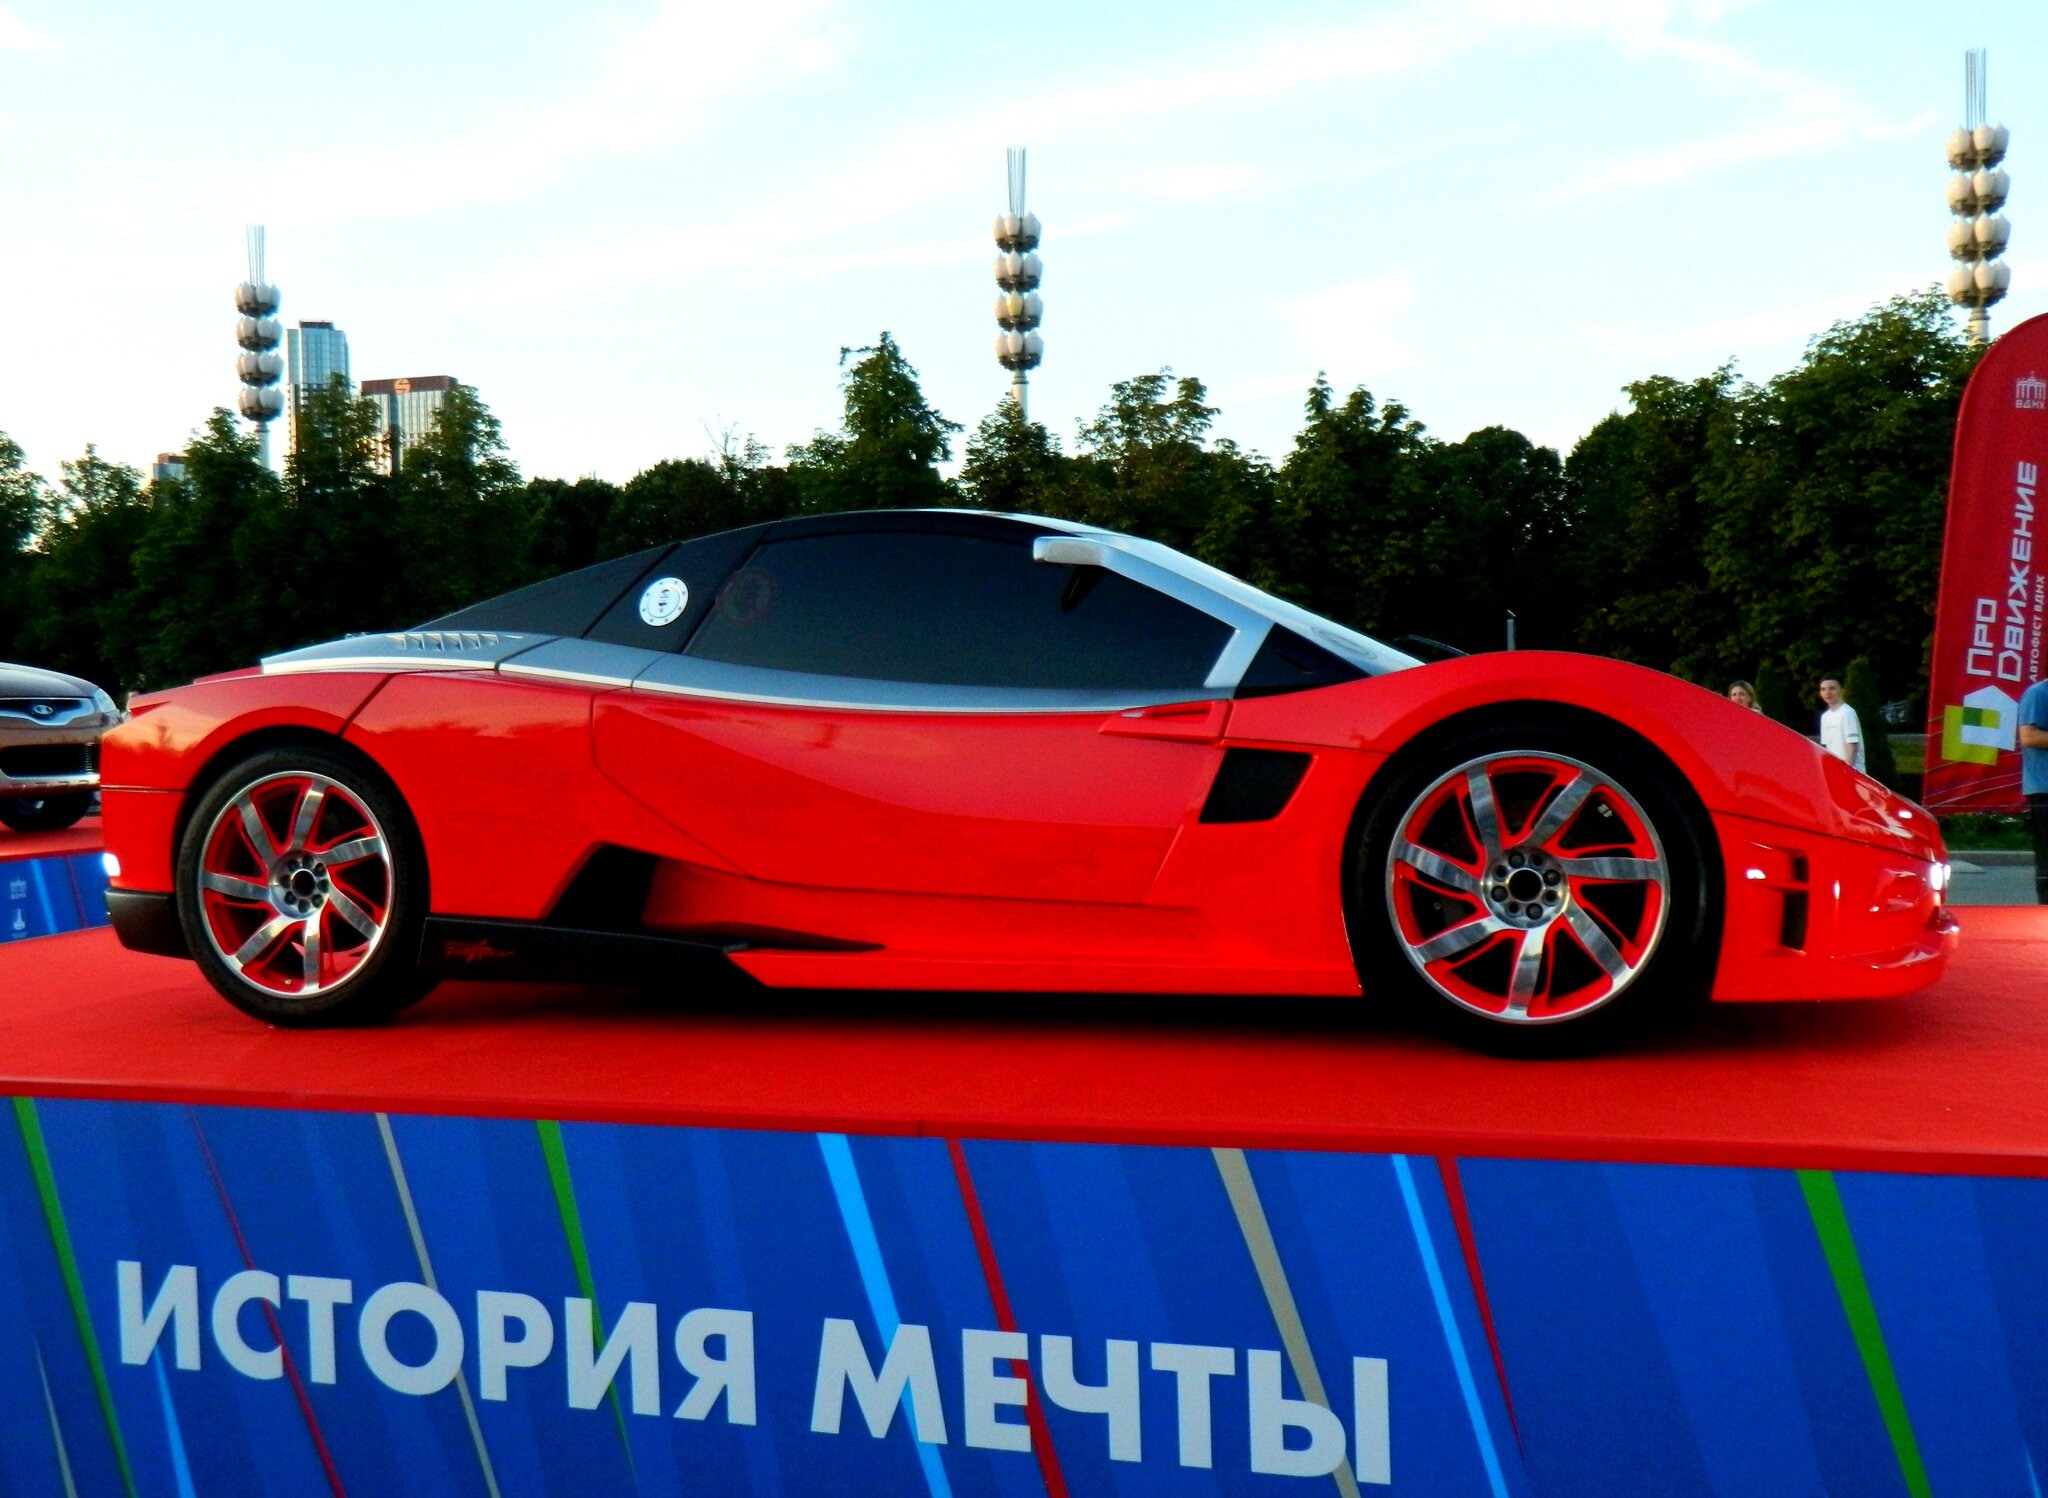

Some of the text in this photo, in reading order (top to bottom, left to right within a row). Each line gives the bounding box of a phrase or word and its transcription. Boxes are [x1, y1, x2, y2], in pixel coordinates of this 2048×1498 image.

[2015, 399, 2046, 410] ВДНХ
[1966, 598, 1998, 678] ПРО
[2029, 574, 2045, 682] АВТОФЕСТ ВДНХ
[116, 1260, 1391, 1485] ИСТОРИЯ МЕЧТЫ
